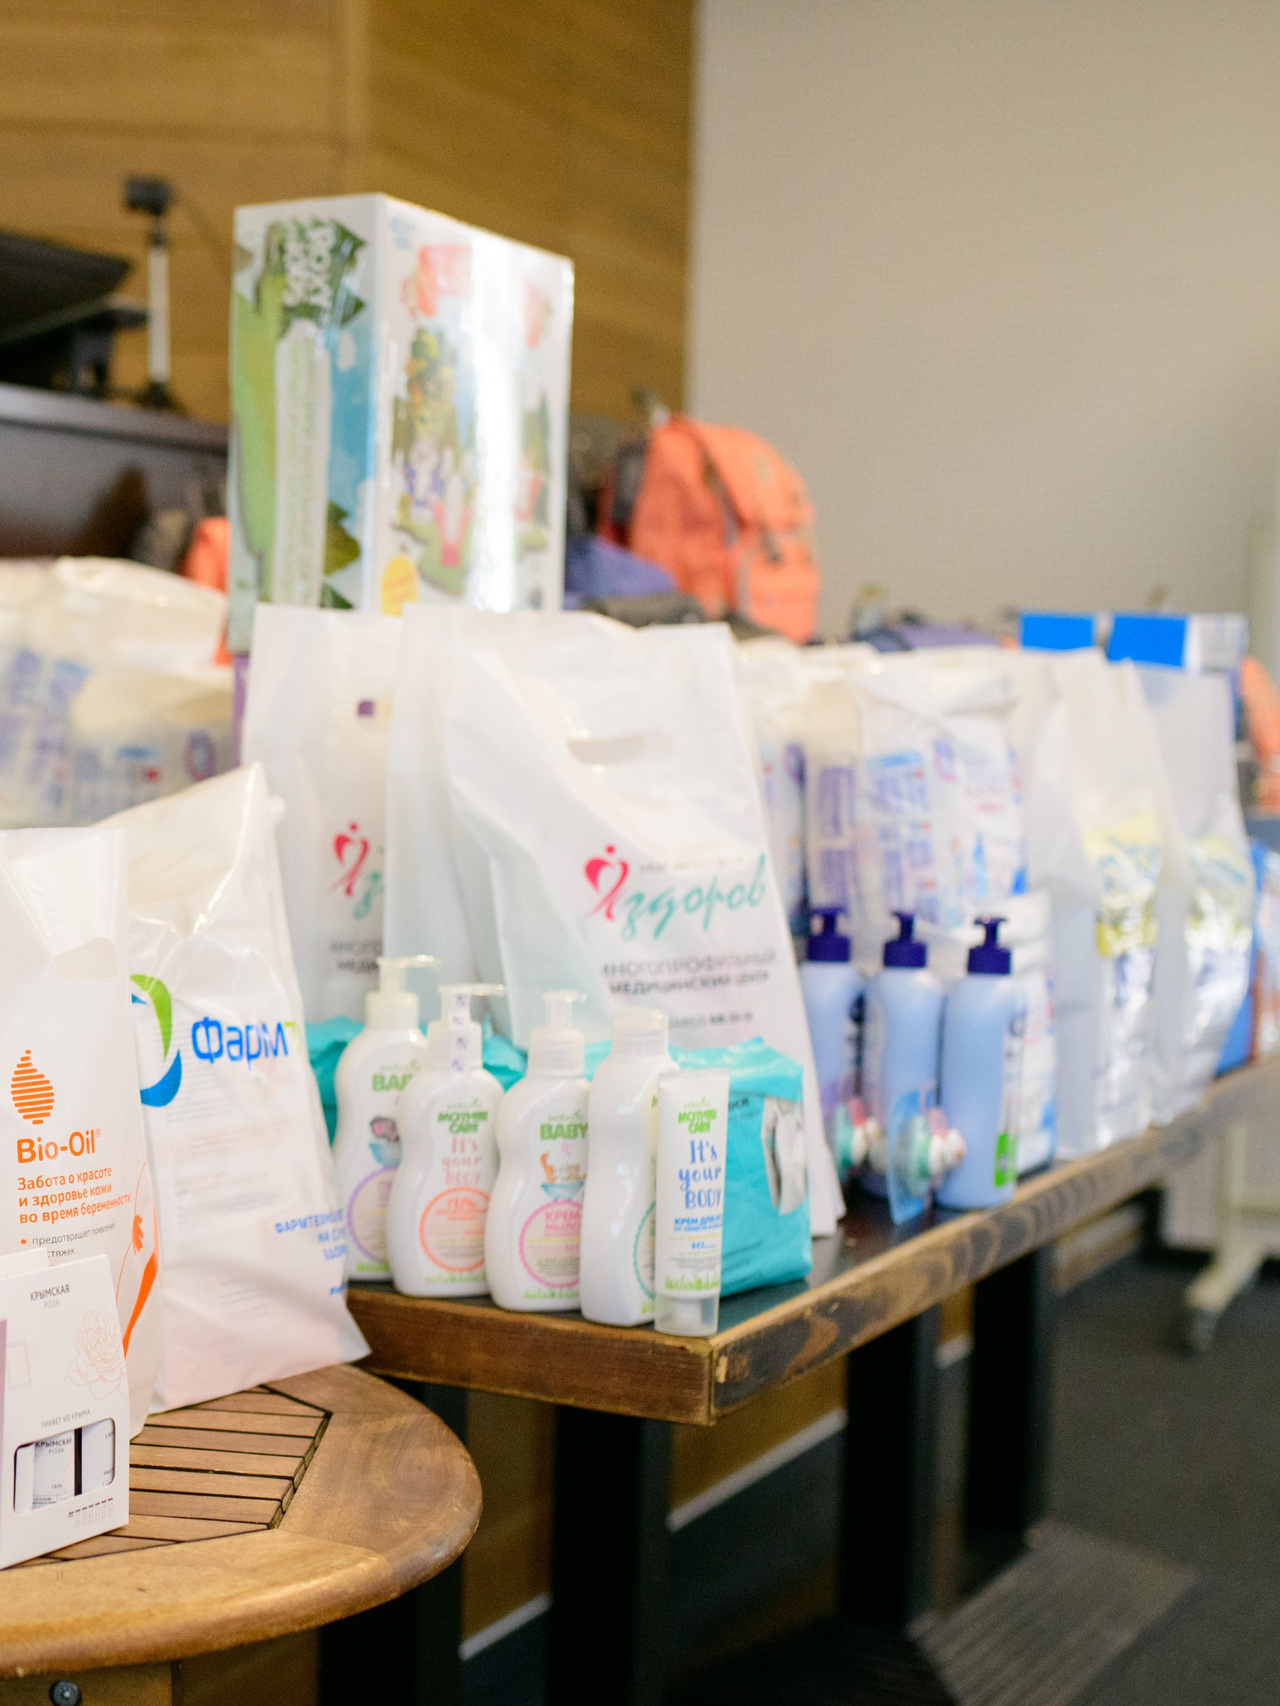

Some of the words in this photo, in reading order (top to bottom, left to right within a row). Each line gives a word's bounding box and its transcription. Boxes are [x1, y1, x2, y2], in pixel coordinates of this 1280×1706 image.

[540, 1122, 588, 1140] BABY
[690, 1139, 717, 1164] It's
[17, 1174, 66, 1191] Забота
[68, 1174, 75, 1184] о
[76, 1166, 112, 1185] красоте
[679, 1166, 721, 1191] your
[19, 1197, 28, 1207] и
[32, 1188, 88, 1207] здоровье
[90, 1184, 112, 1197] кожи
[19, 1213, 38, 1224] во
[42, 1207, 79, 1224] время
[80, 1193, 131, 1217] беременности
[32, 1231, 91, 1247] предотвращает
[30, 1284, 70, 1301] КРЫМСКАЯ
[44, 1299, 60, 1309] РОЗА
[41, 1417, 61, 1429] ПРИВЕТ
[72, 1409, 91, 1421] КРЫМА
